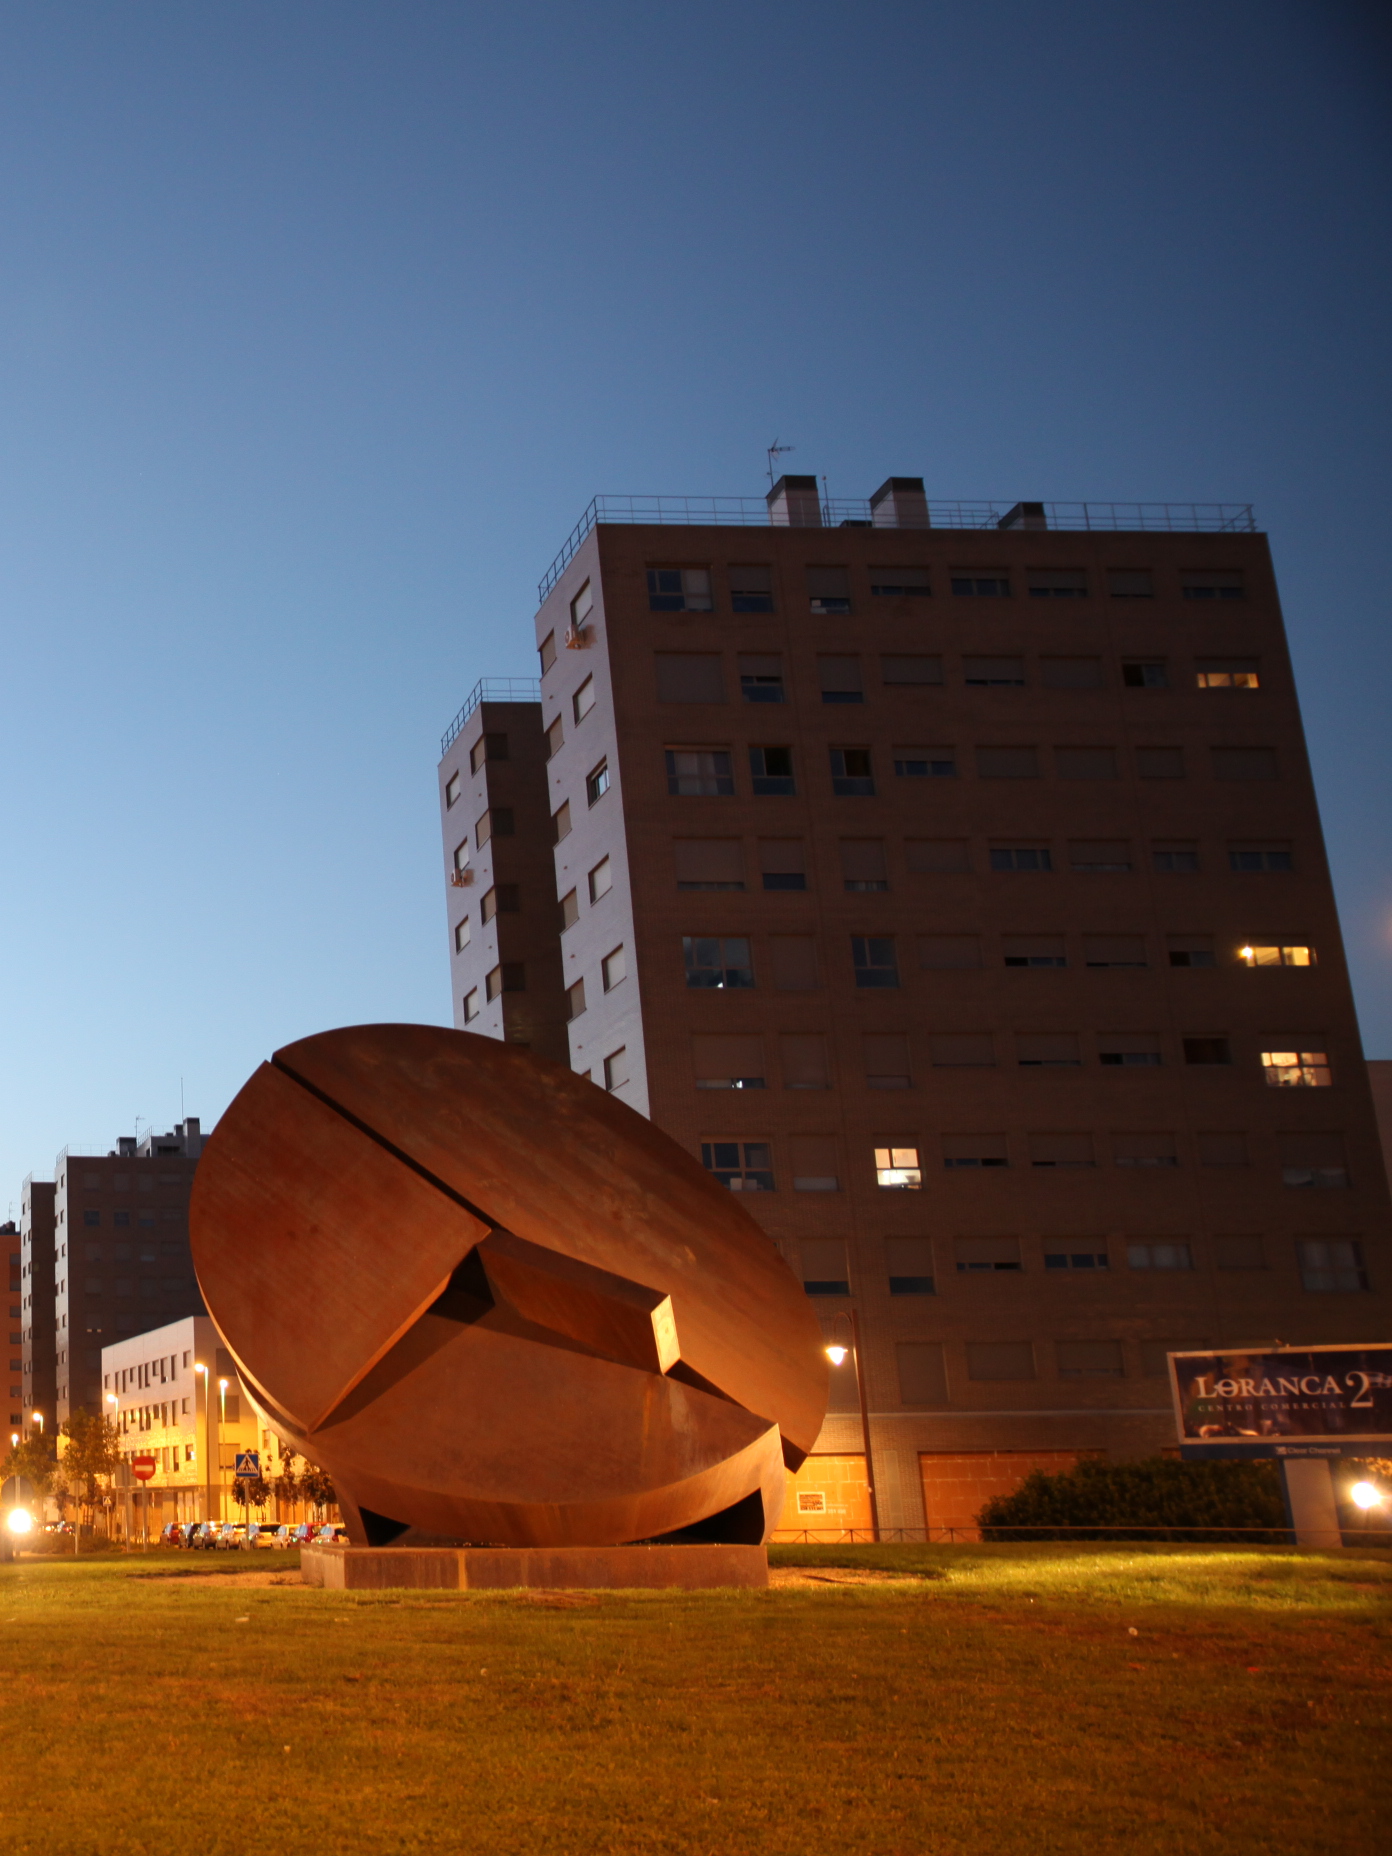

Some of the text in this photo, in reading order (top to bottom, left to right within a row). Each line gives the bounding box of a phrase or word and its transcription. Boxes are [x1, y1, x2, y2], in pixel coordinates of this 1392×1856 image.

[1195, 1371, 1374, 1408] LORANCA 2
[1198, 1401, 1346, 1412] CENTRO COMERCIAL
